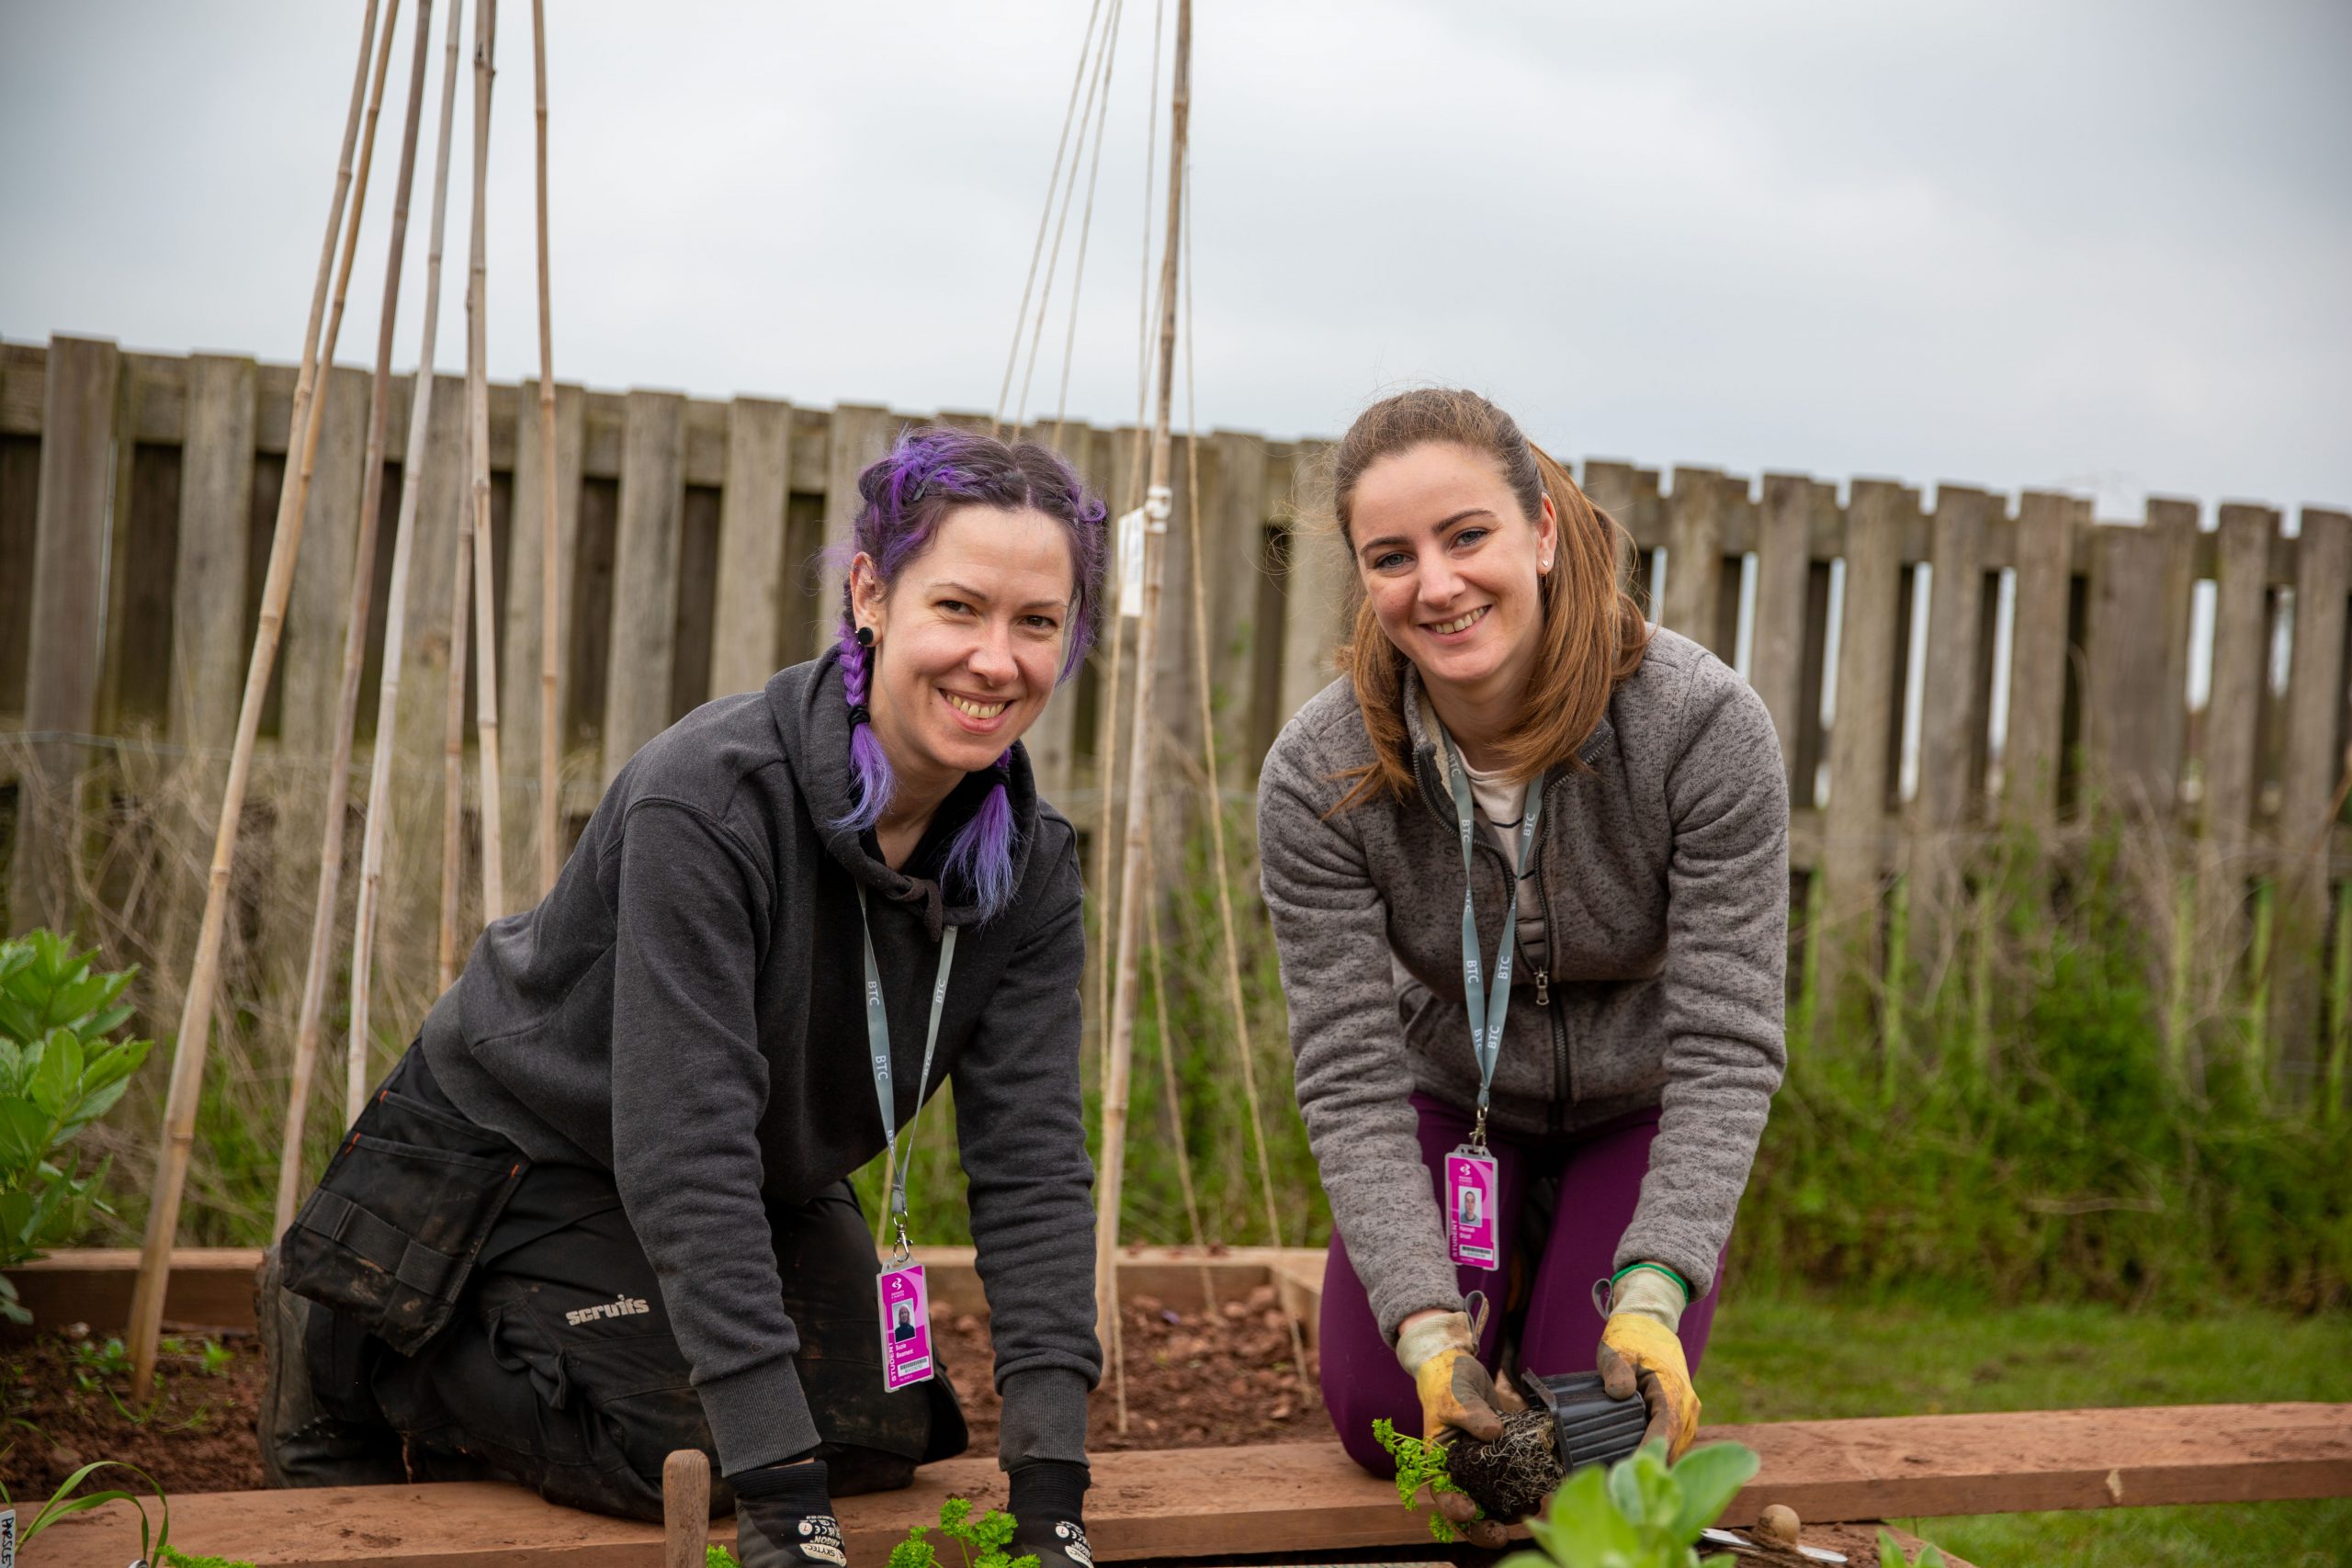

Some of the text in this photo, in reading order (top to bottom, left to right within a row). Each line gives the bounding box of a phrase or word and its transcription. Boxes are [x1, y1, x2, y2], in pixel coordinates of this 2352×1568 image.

[1462, 818, 1470, 843] BTC
[1523, 812, 1536, 837] BTC
[1465, 960, 1479, 985] BTC
[1498, 955, 1510, 980] BTC
[867, 980, 880, 1006] BTC
[935, 978, 946, 1004] BTC
[1487, 1024, 1500, 1050] BTC
[875, 1055, 888, 1080] BTC
[888, 1342, 896, 1382] STUDENT
[1, 1517, 15, 1568] PARSLE
[808, 1545, 835, 1556] SKYTEC
